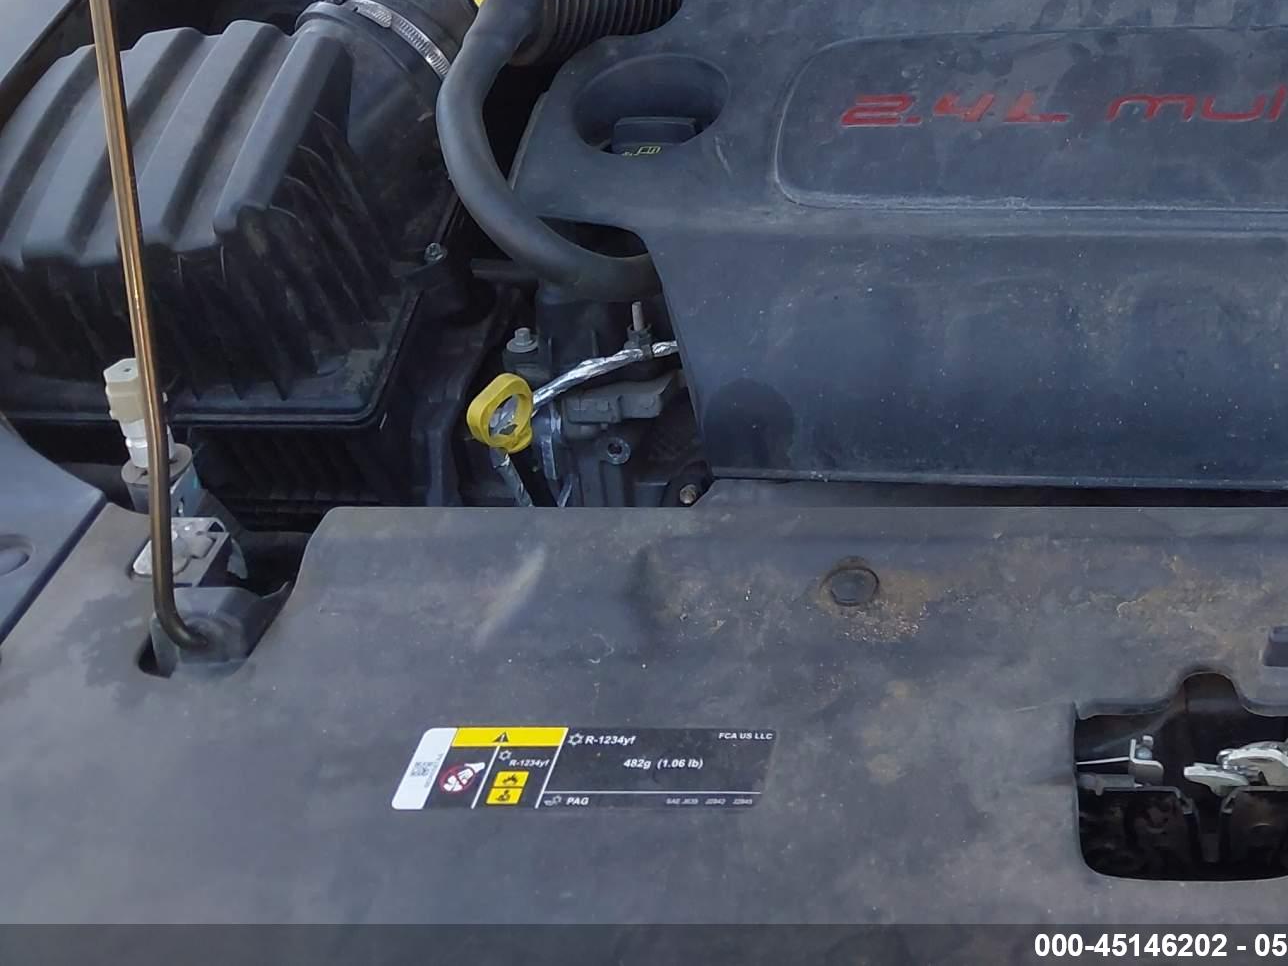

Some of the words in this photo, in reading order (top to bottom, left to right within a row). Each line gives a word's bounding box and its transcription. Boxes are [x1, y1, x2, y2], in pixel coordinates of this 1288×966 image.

[840, 91, 1070, 127] 2.4L
[584, 735, 636, 746] R-1234yf
[718, 732, 737, 740] FCA
[739, 732, 752, 740] US
[754, 732, 774, 740] LLC
[508, 758, 550, 768] R-1234yf
[623, 758, 652, 770] 482g
[656, 758, 687, 770] (1.06
[688, 758, 704, 770] lb)
[566, 797, 590, 806] PAG
